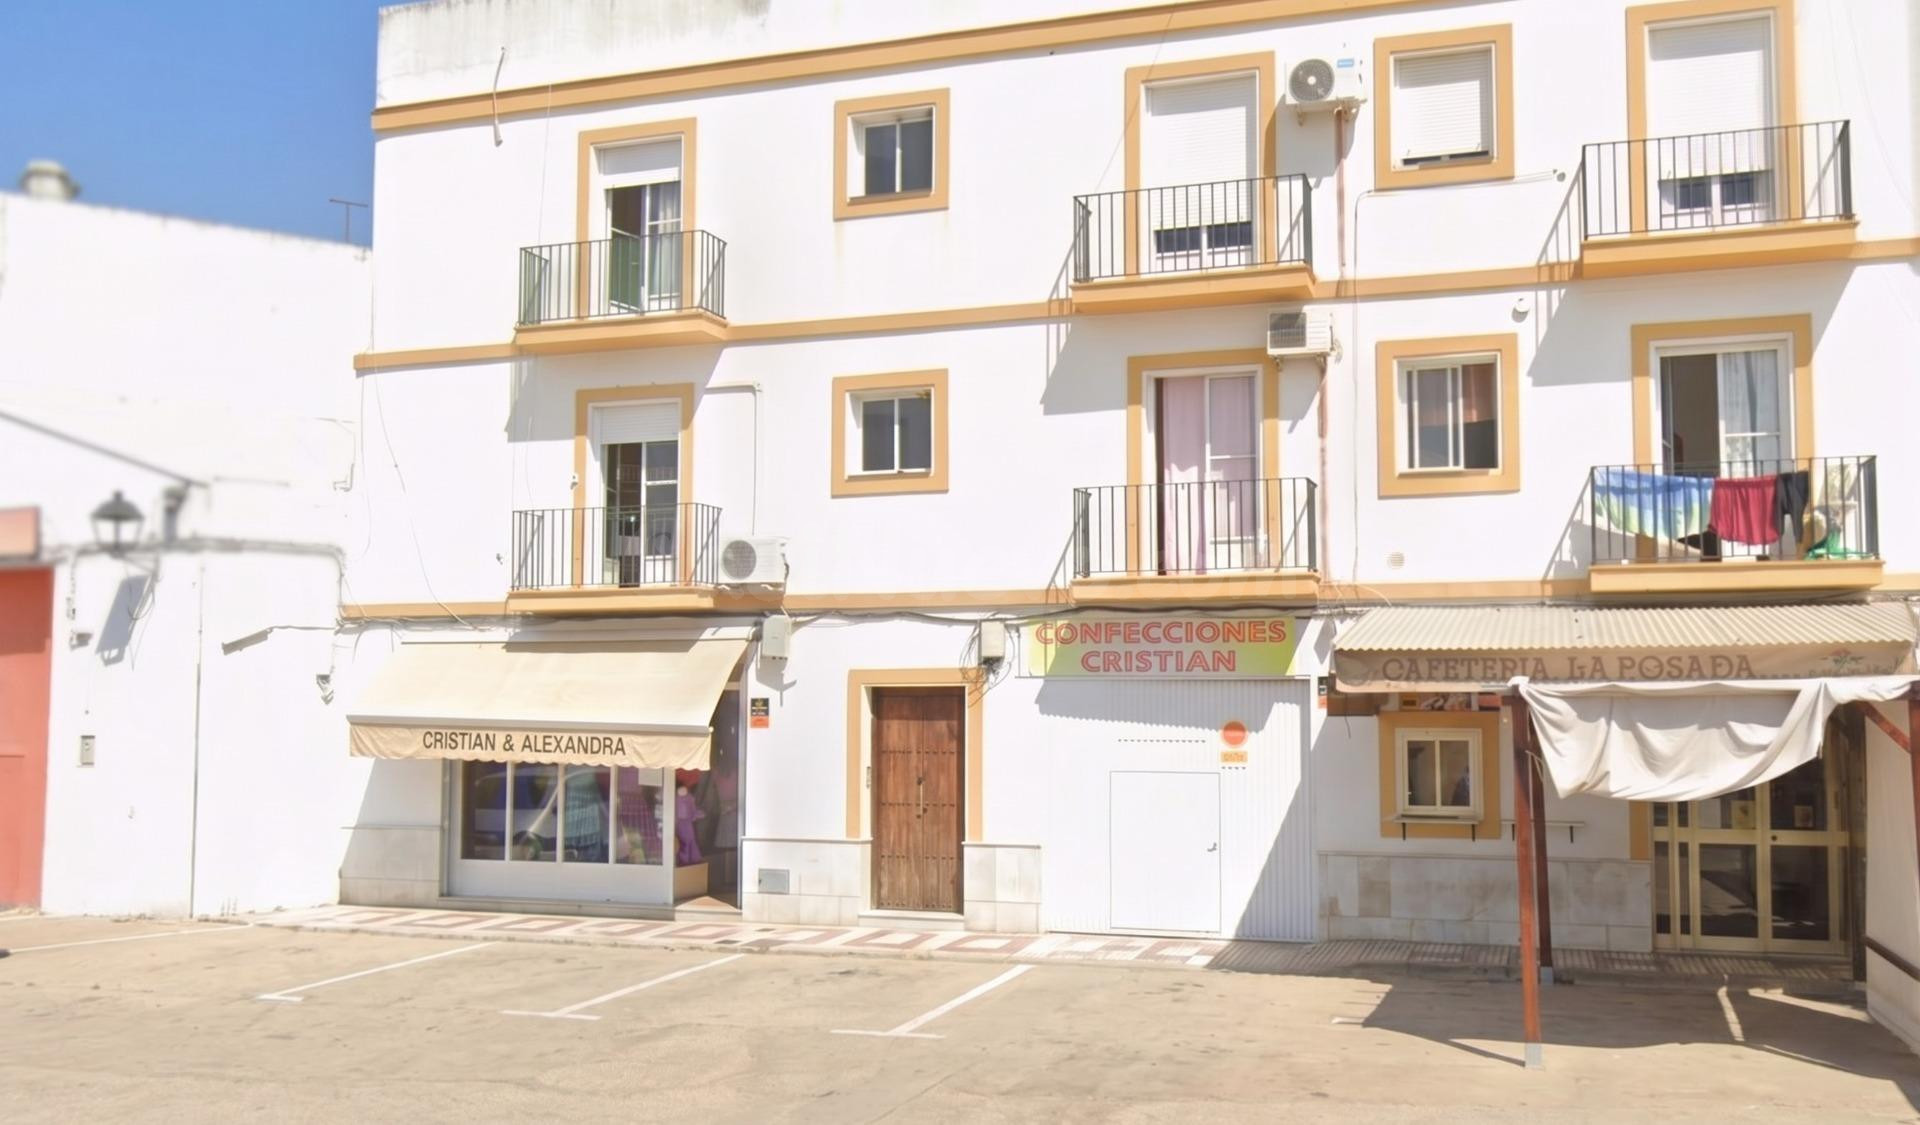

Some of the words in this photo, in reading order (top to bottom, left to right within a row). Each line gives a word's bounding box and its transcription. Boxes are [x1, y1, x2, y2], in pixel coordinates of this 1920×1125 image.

[1036, 621, 1287, 645] CONFECCIONES
[1081, 650, 1236, 672] CRISTIAN
[1568, 656, 1607, 681] LA
[422, 731, 496, 750] CRISTIAN
[503, 734, 515, 752] &
[521, 735, 626, 755] ALEXANDRA
